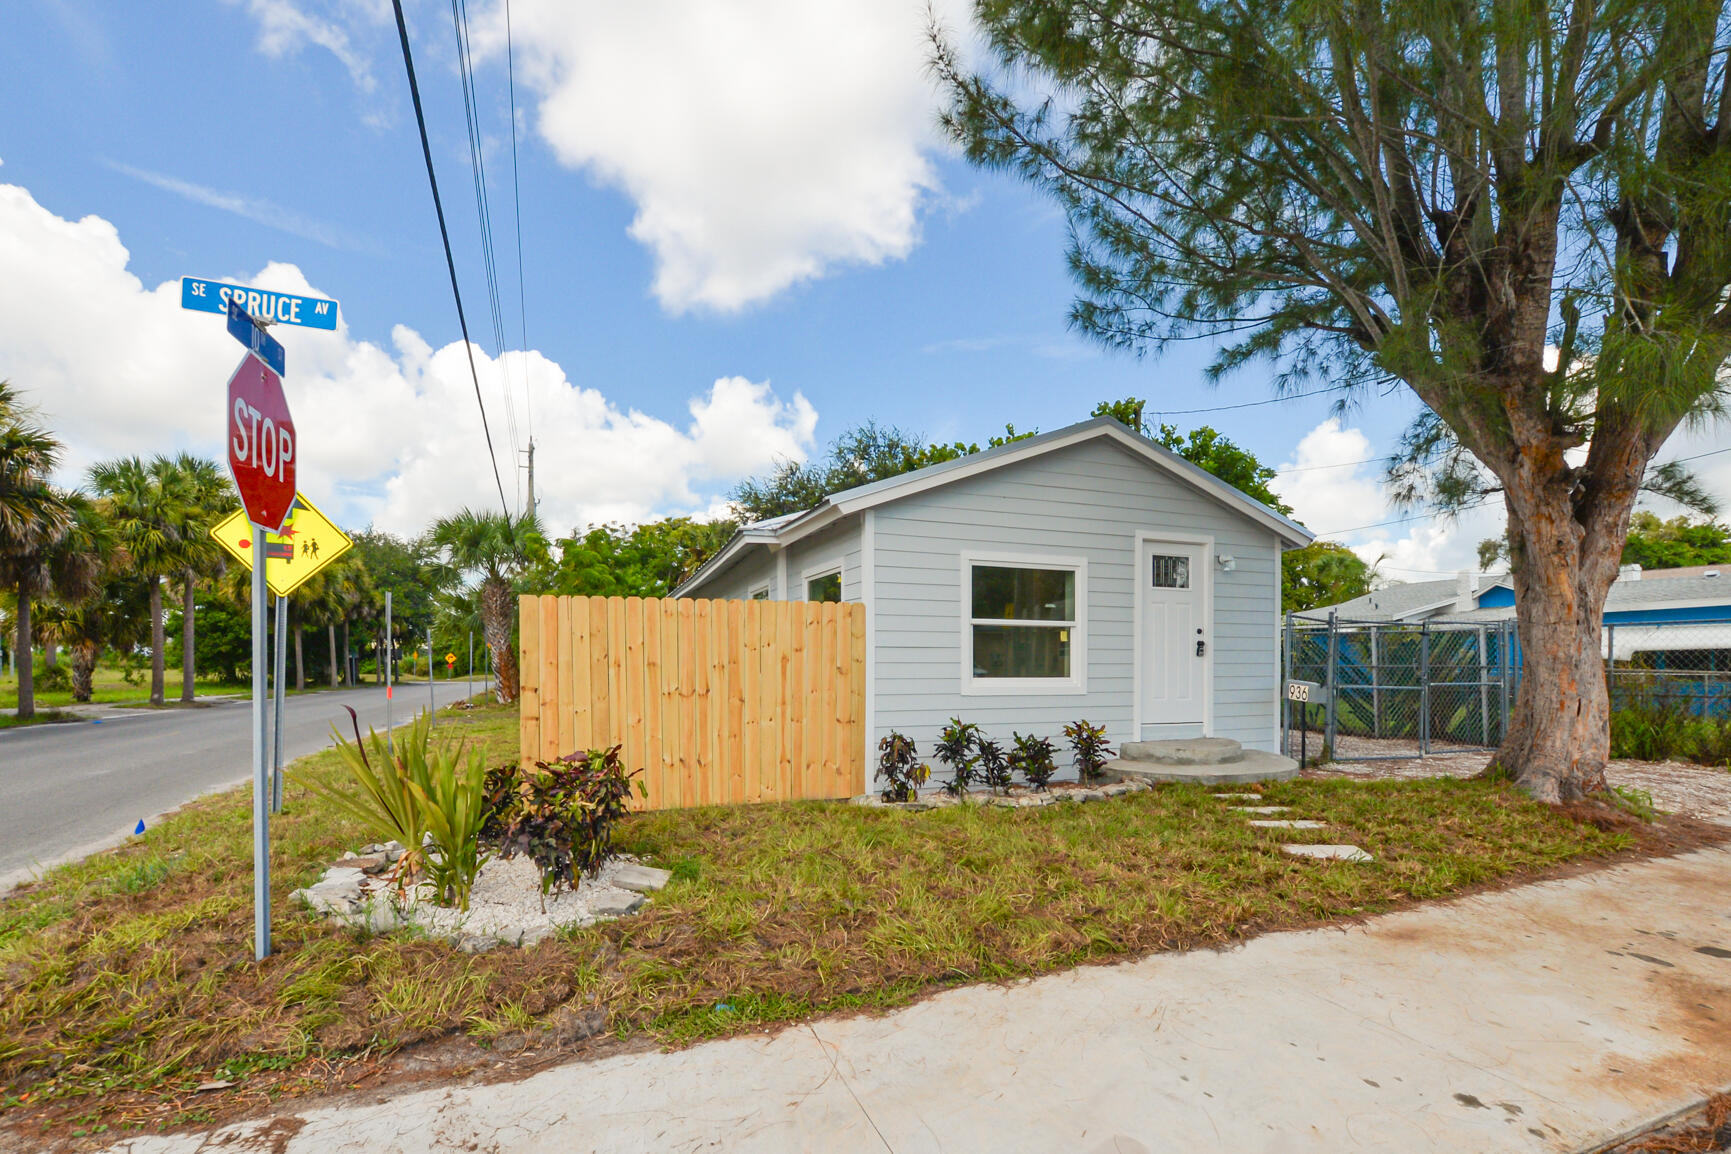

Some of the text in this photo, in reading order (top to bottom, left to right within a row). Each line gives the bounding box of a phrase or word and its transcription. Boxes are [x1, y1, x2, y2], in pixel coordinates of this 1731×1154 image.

[191, 282, 206, 297] SE
[218, 287, 302, 323] SPRUCE
[315, 302, 329, 315] AV
[233, 398, 292, 483] STOP
[1290, 685, 1307, 700] 936
